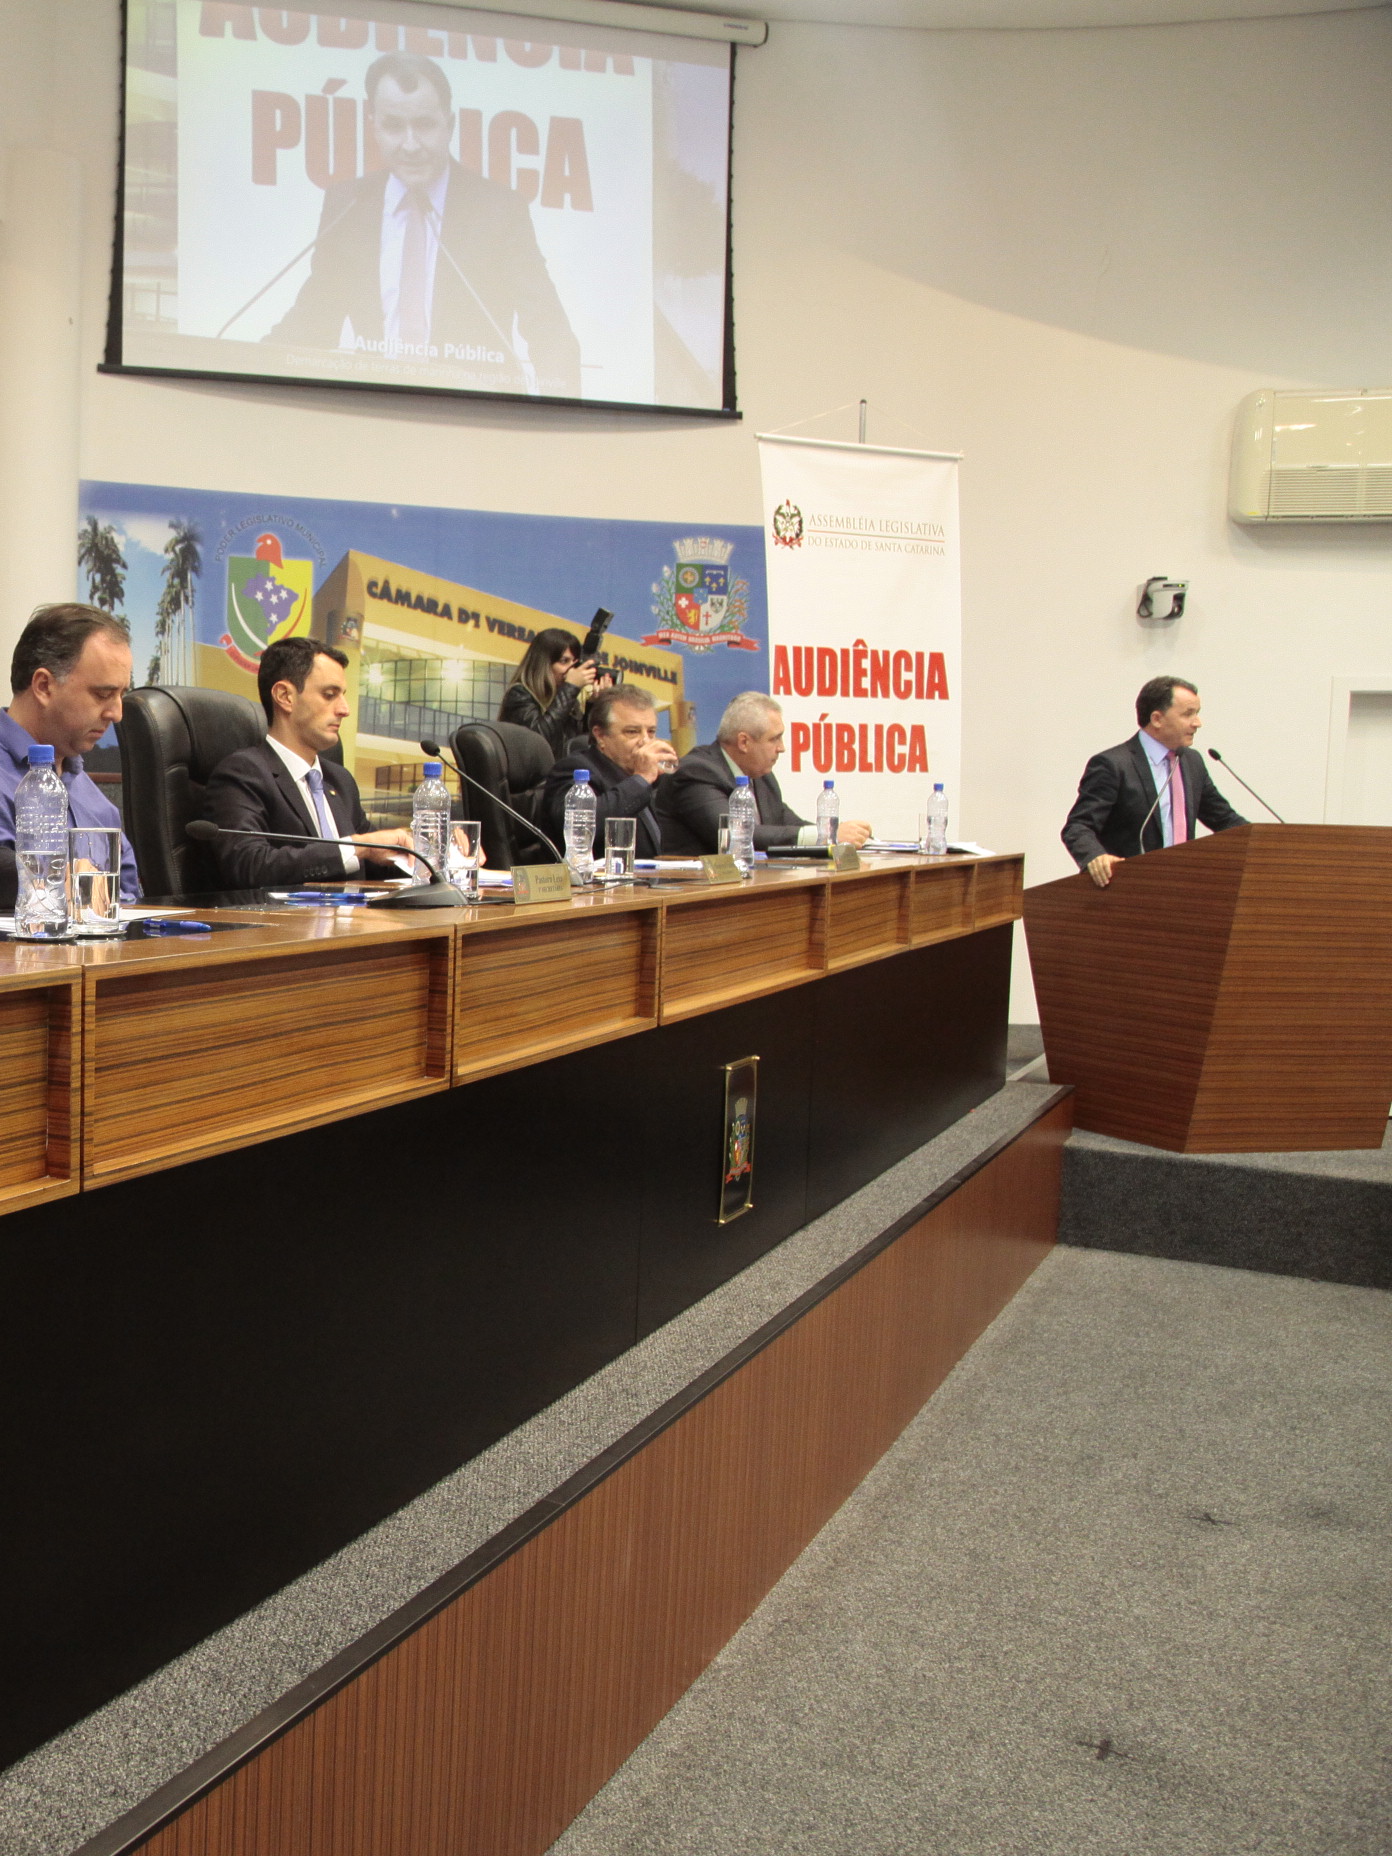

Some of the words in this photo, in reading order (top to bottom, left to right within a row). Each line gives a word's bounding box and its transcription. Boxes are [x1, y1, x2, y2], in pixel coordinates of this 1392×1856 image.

[252, 78, 593, 212] PÚICA
[356, 335, 439, 358] Audiência
[444, 342, 505, 363] Pública
[215, 529, 237, 562] PODER
[236, 515, 294, 532] LEGISLATIVO
[295, 522, 327, 568] MUNICIPAL
[808, 536, 822, 547] DO
[825, 537, 859, 550] ESTADO
[861, 540, 873, 550] DE
[875, 542, 903, 553] SANTA
[905, 544, 946, 557] CATARINA
[809, 514, 876, 532] ASSEMBLÉIA
[879, 519, 945, 538] LEGISLATIVA
[366, 578, 454, 621] CÂMARA
[612, 654, 678, 686] JOINVILLE
[773, 638, 950, 700] AUDIÊNCIA
[790, 712, 929, 774] PÚBLICA
